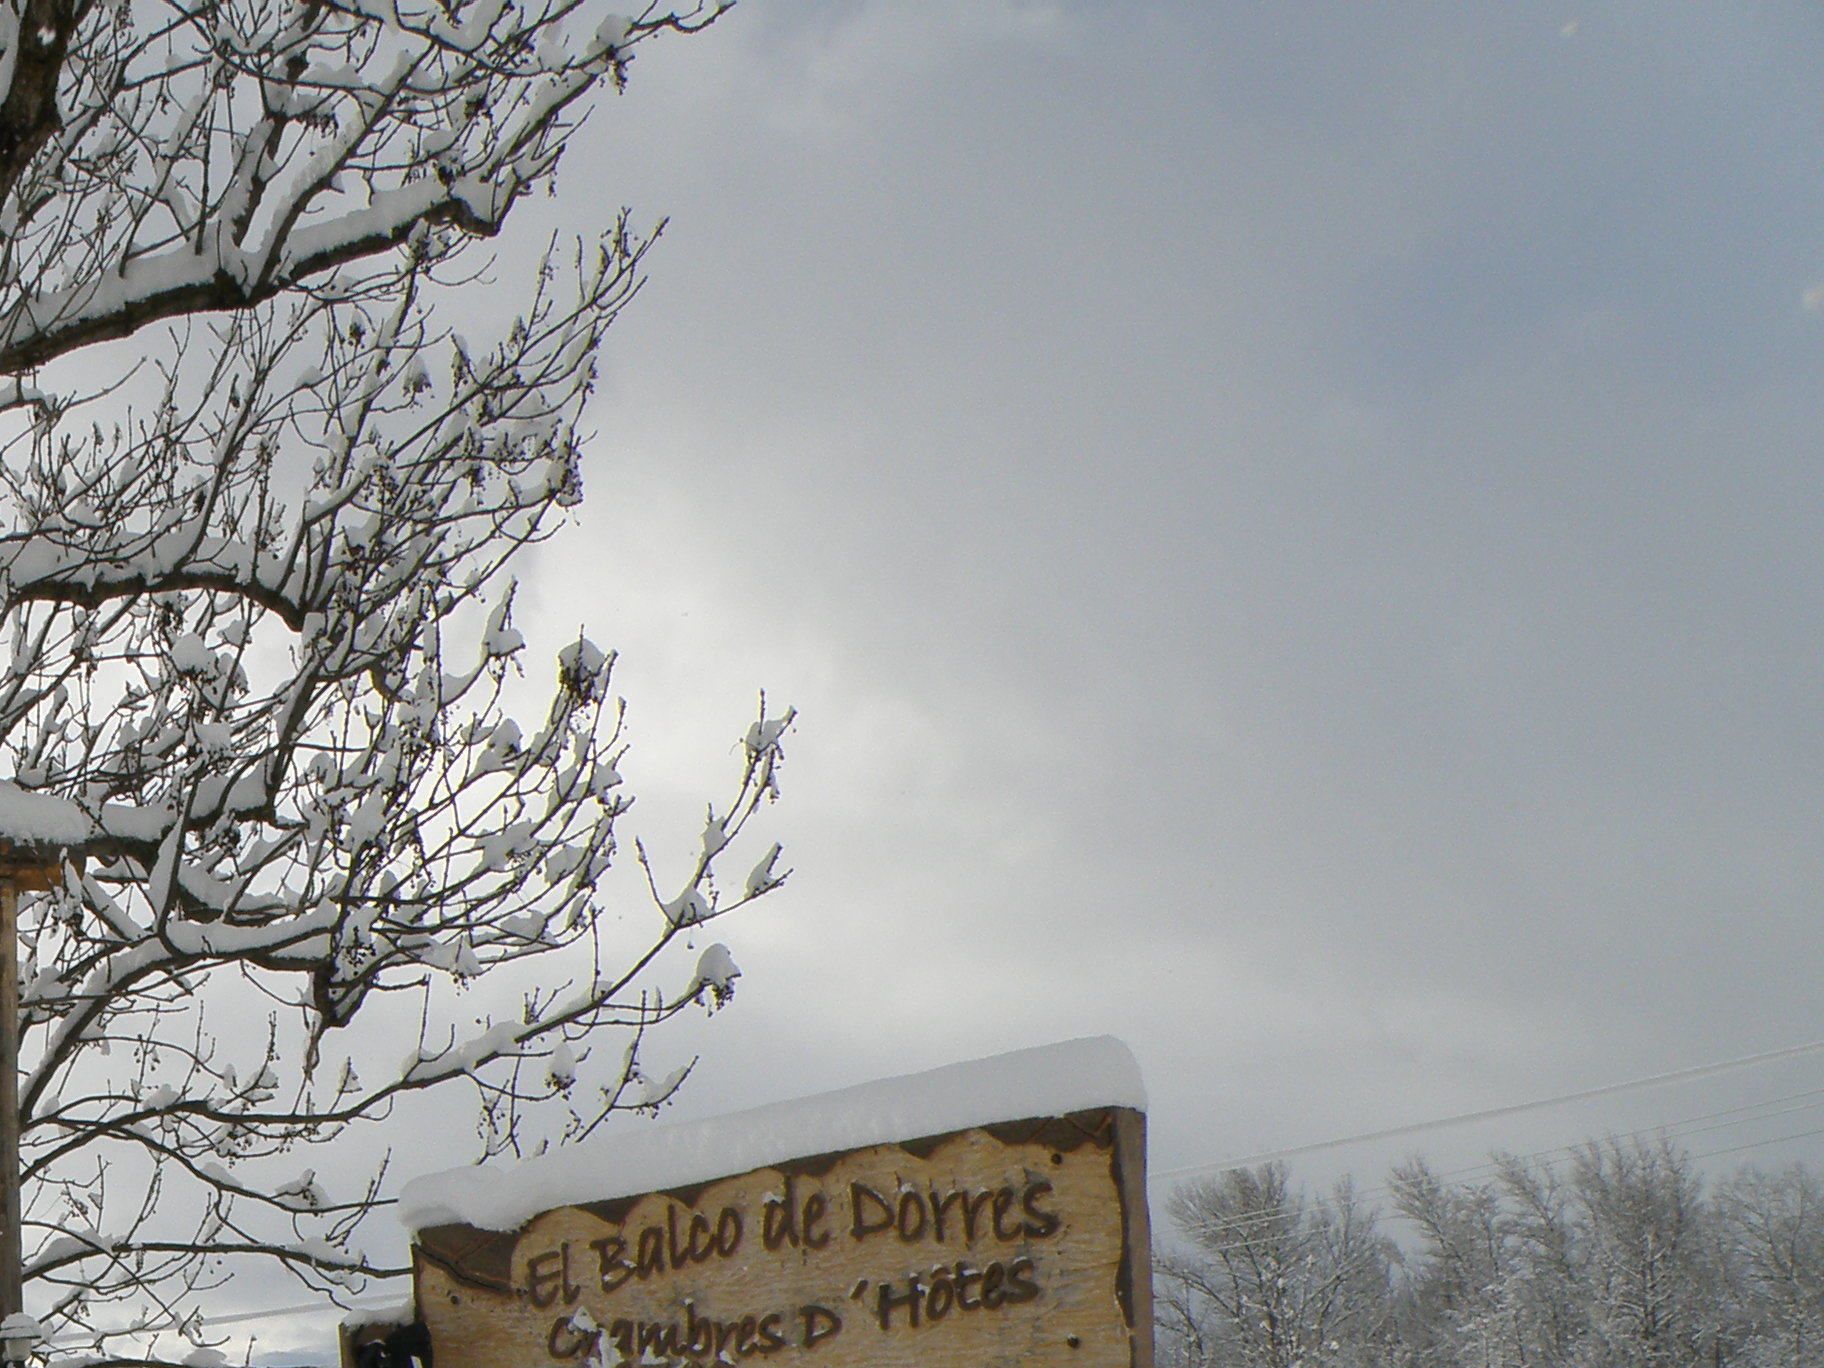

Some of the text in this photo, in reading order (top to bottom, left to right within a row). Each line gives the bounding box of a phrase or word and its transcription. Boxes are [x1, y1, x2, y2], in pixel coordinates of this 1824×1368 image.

[526, 1174, 1060, 1308] El Balco de Dorres
